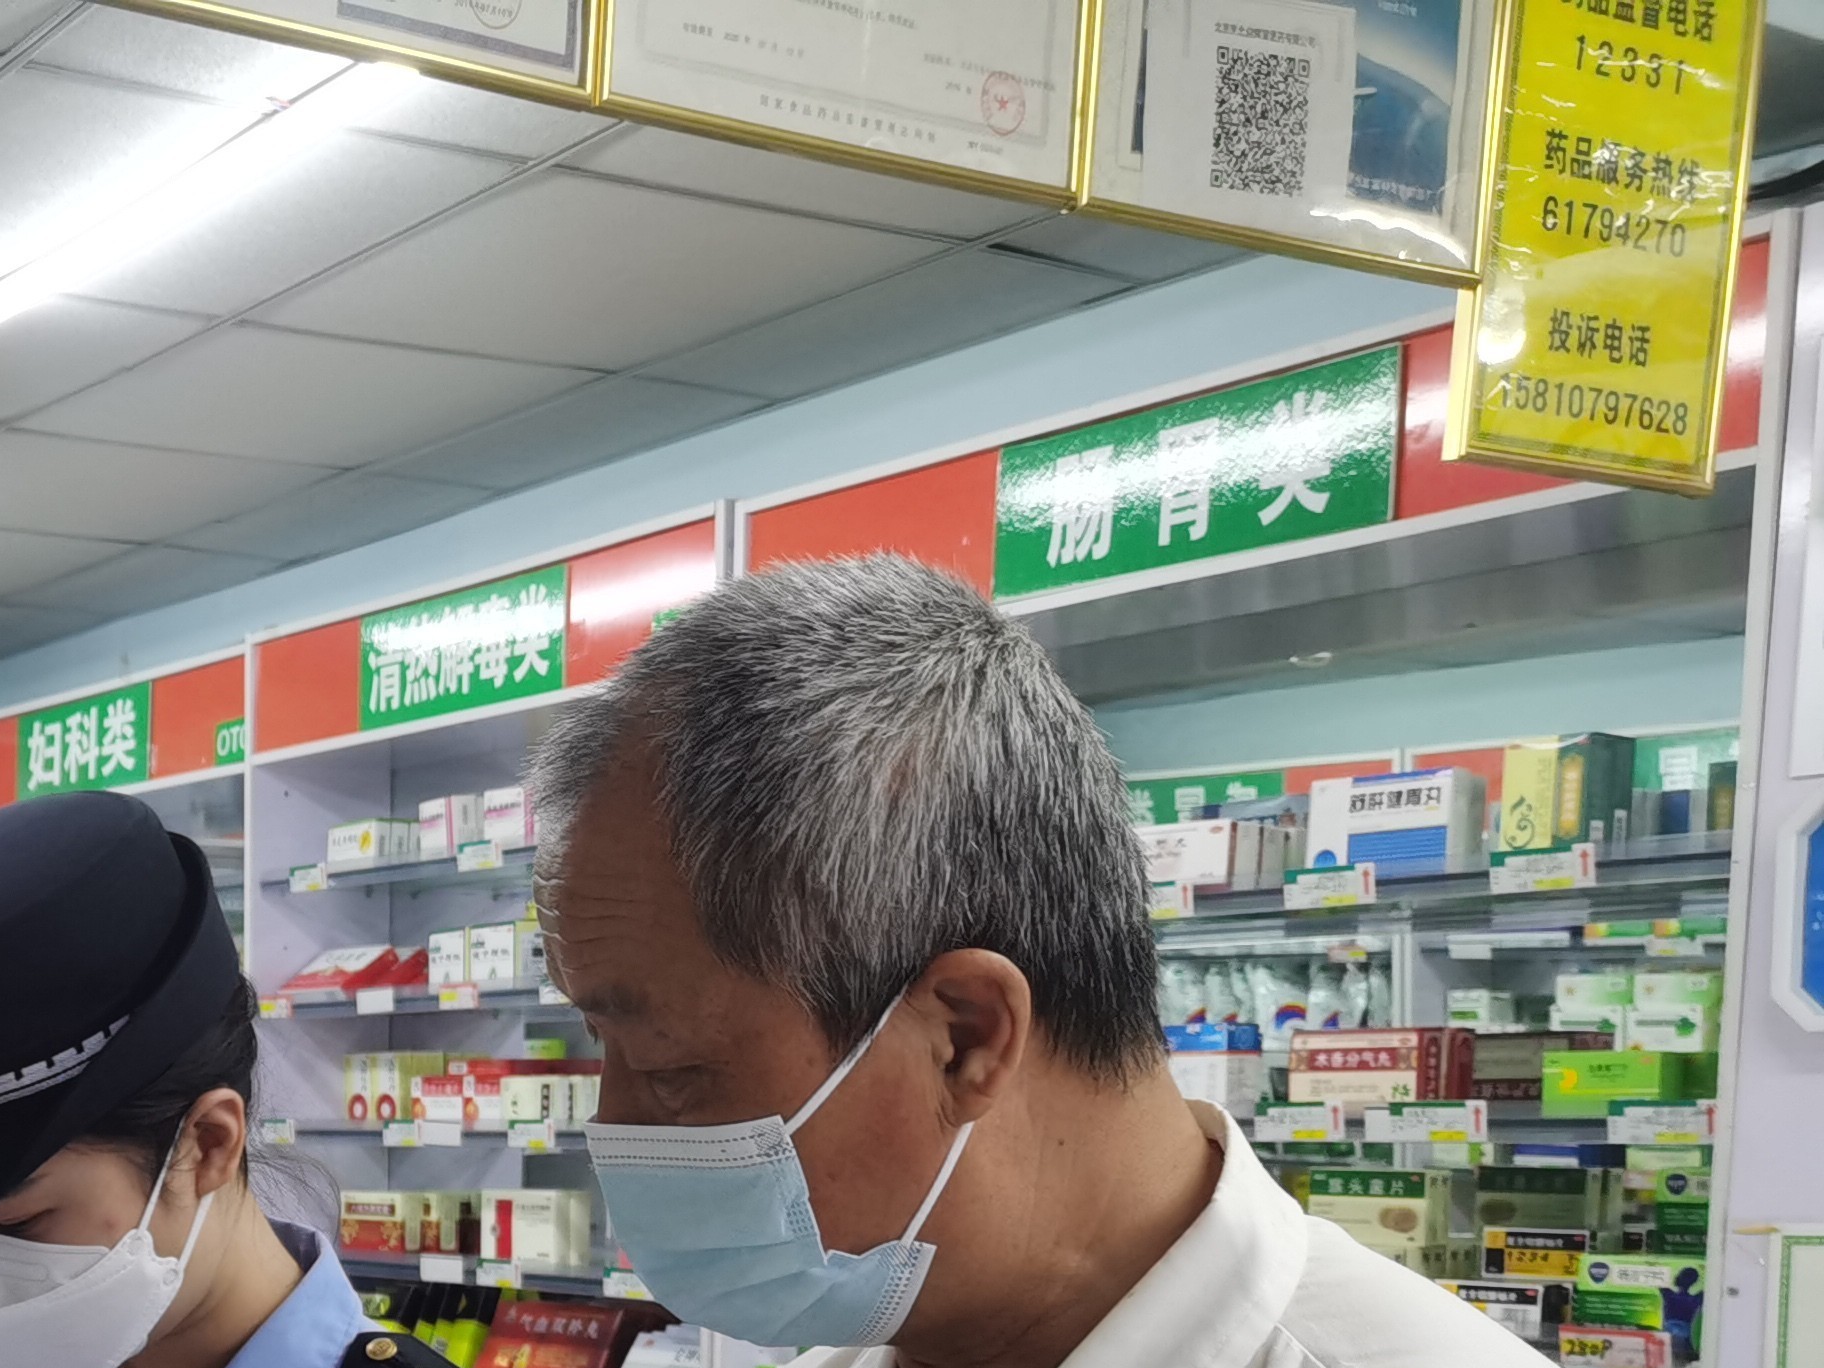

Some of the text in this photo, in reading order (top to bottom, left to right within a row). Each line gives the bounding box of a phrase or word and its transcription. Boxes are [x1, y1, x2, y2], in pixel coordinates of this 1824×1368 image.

[1576, 34, 1685, 95] 12331
[1542, 196, 1686, 258] 61794270
[1548, 308, 1651, 367] 投诉电话
[1500, 372, 1688, 436] 15810797628
[27, 698, 136, 791] 妇科类
